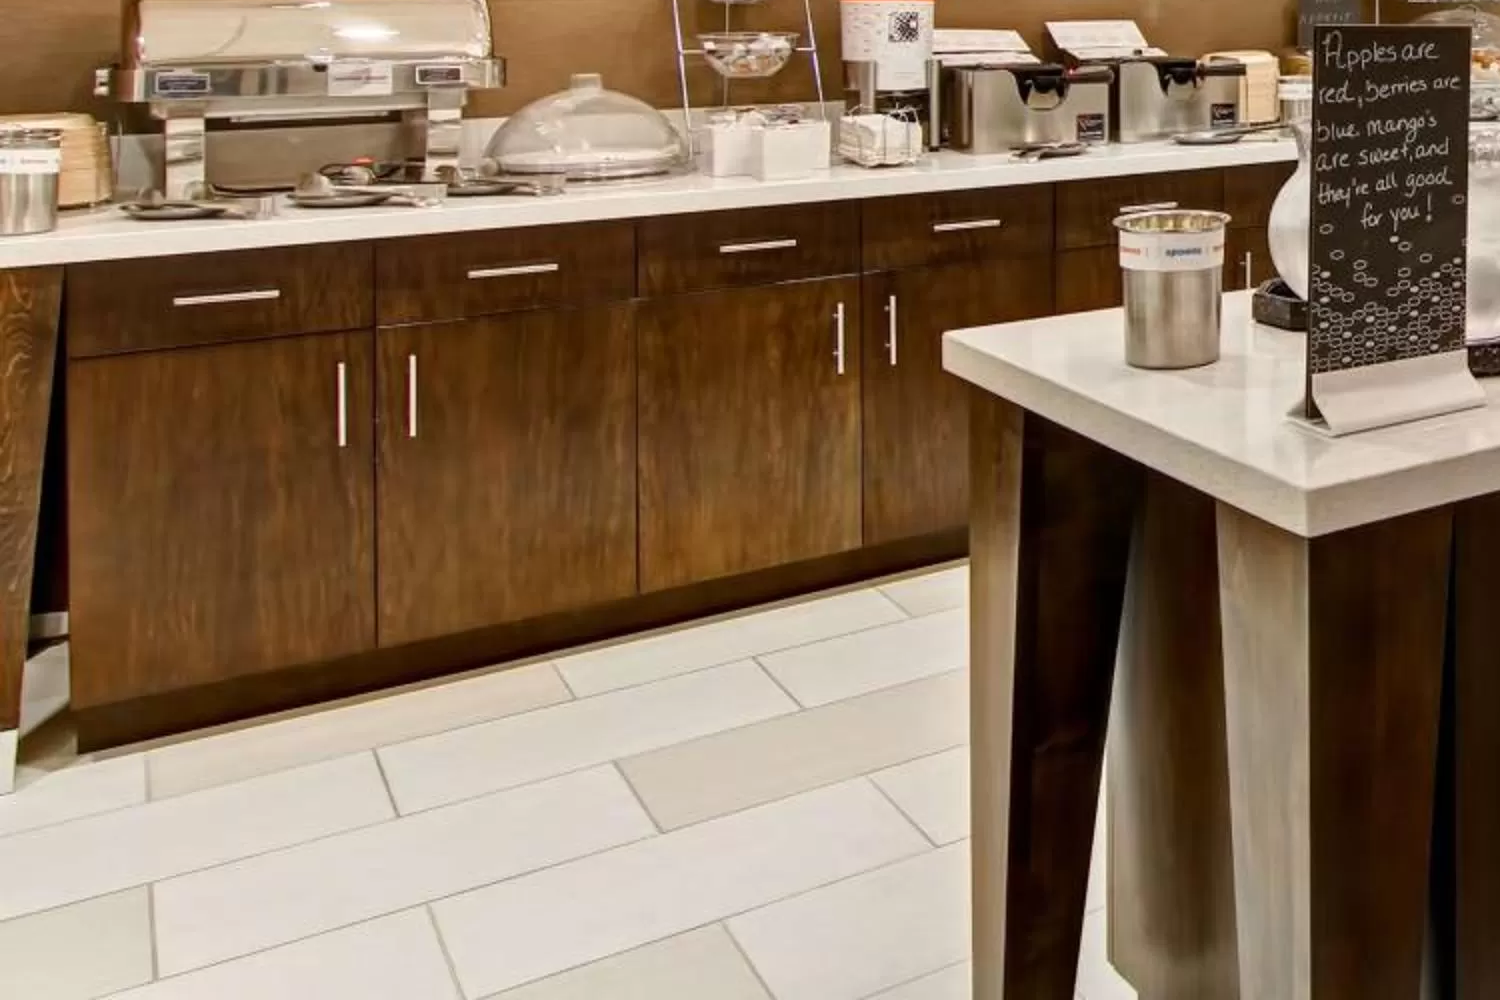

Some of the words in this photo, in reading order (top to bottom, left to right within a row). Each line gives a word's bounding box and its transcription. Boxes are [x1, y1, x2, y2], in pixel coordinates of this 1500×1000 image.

[1321, 29, 1397, 72] Apples
[1401, 41, 1440, 60] are
[1433, 76, 1461, 90] are
[1315, 152, 1351, 172] are
[1415, 136, 1450, 159] and
[1317, 177, 1370, 208] they're
[1375, 172, 1398, 192] all
[1405, 165, 1453, 198] good
[1360, 202, 1383, 230] for
